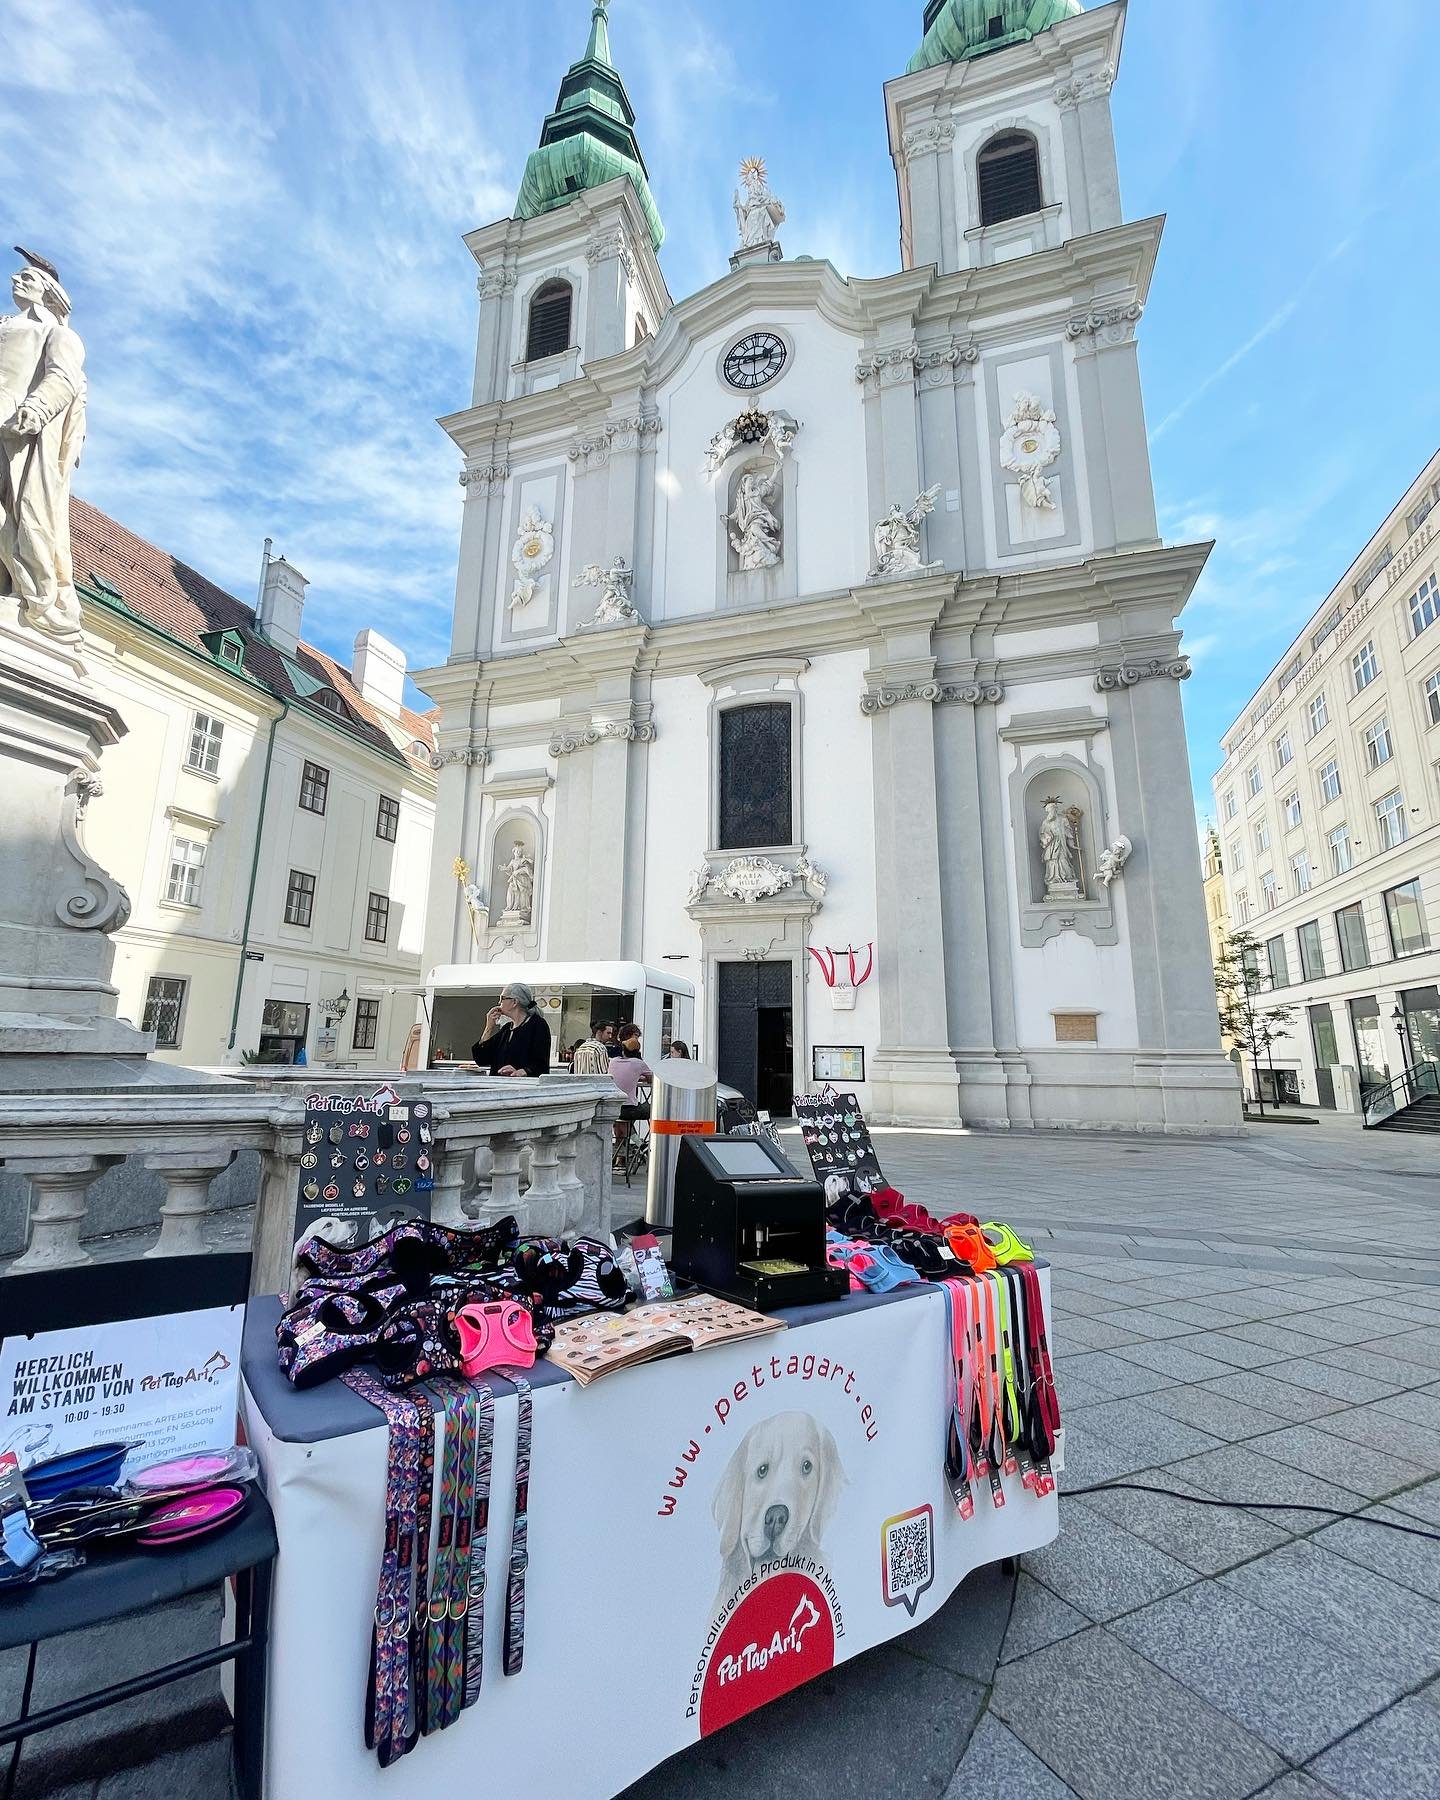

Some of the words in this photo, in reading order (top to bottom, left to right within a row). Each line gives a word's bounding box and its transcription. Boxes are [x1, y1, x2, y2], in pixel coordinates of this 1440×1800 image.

[15, 1351, 94, 1378] HERZLICH
[13, 1363, 123, 1397] WILLKOMMEN
[8, 1399, 35, 1416] AM
[41, 1387, 95, 1410] STAND
[103, 1379, 134, 1397] VON
[195, 1404, 222, 1416] GmbH
[64, 1411, 89, 1424] 10:00
[166, 1420, 179, 1433] FN
[686, 1571, 757, 1718] Personalisiertes
[760, 1552, 805, 1578] Produkt
[806, 1557, 816, 1574] in
[815, 1565, 824, 1579] 2
[821, 1573, 846, 1639] Minuten!
